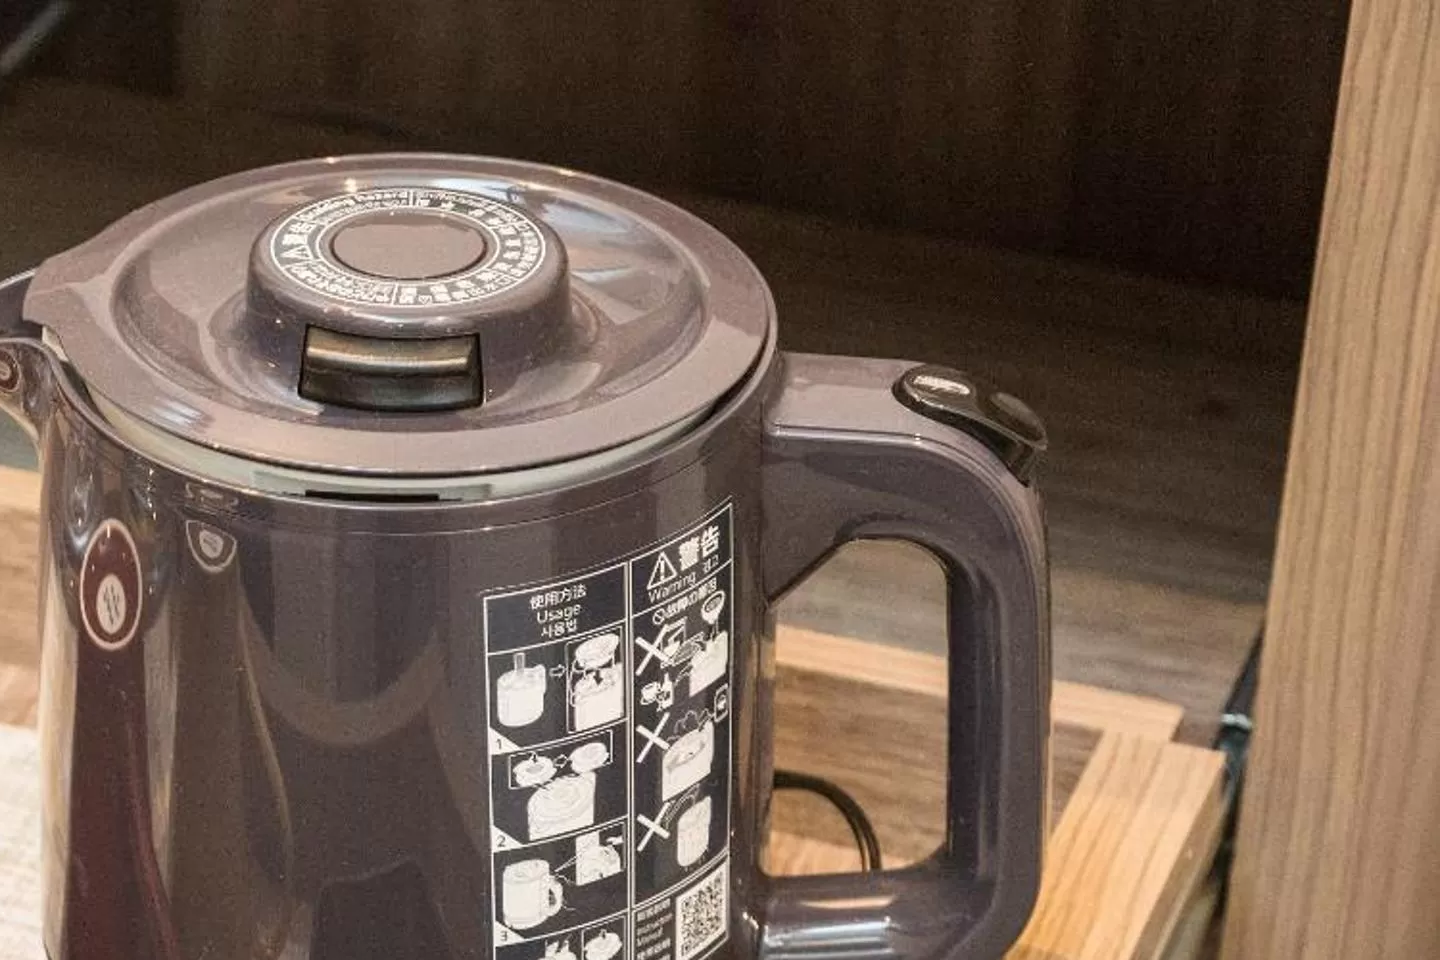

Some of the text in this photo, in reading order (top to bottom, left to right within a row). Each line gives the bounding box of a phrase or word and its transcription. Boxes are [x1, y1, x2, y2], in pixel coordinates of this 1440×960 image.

[530, 584, 587, 610] 使用方法
[648, 572, 696, 603] Warning
[537, 604, 581, 624] Usage
[496, 836, 507, 848] 2
[500, 931, 509, 942] 3
